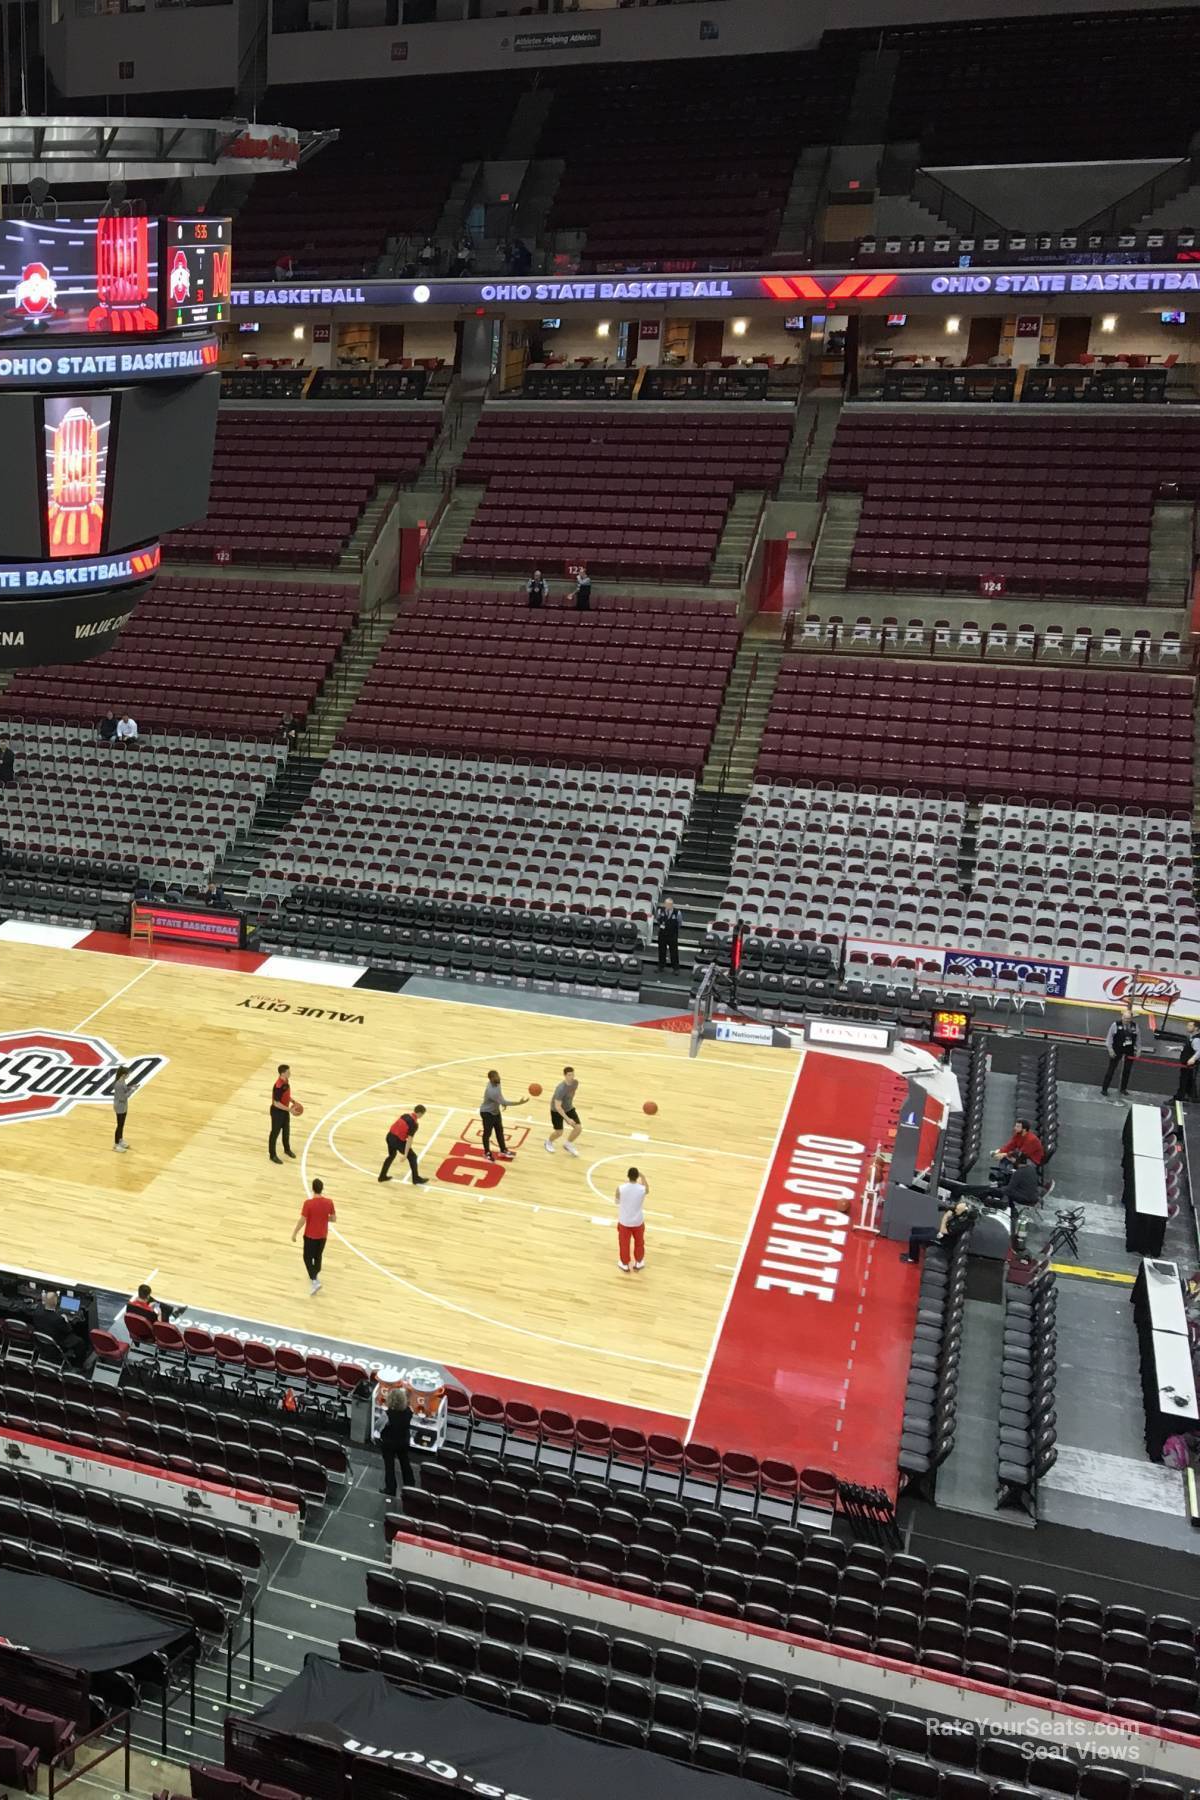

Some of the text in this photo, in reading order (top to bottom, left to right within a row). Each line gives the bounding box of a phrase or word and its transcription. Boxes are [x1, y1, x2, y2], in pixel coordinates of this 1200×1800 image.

[212, 252, 229, 297] M
[481, 281, 732, 300] OHIO STATE BASKETBALL
[931, 273, 1200, 293] OHIO STATE BASKETBA
[254, 289, 365, 304] BASKETBALL
[315, 330, 329, 338] 222
[642, 326, 658, 334] 223
[1019, 322, 1037, 331] 224
[57, 355, 116, 374] STATE
[120, 350, 203, 371] BASKETBALL
[216, 550, 230, 561] 122
[26, 561, 133, 586] BASKETBALL
[984, 582, 1001, 591] 124
[74, 620, 112, 639] VALUE
[156, 917, 181, 928] STATE
[183, 921, 238, 935] BASKETBALL
[1105, 973, 1181, 1001] Cane's
[236, 998, 365, 1024] VALUE CITY
[937, 1011, 967, 1025] 15:35
[731, 1031, 771, 1041] Nationwide
[817, 1026, 879, 1041] HONDA
[940, 1024, 959, 1038] 30
[754, 1134, 866, 1302] OHIO STATE
